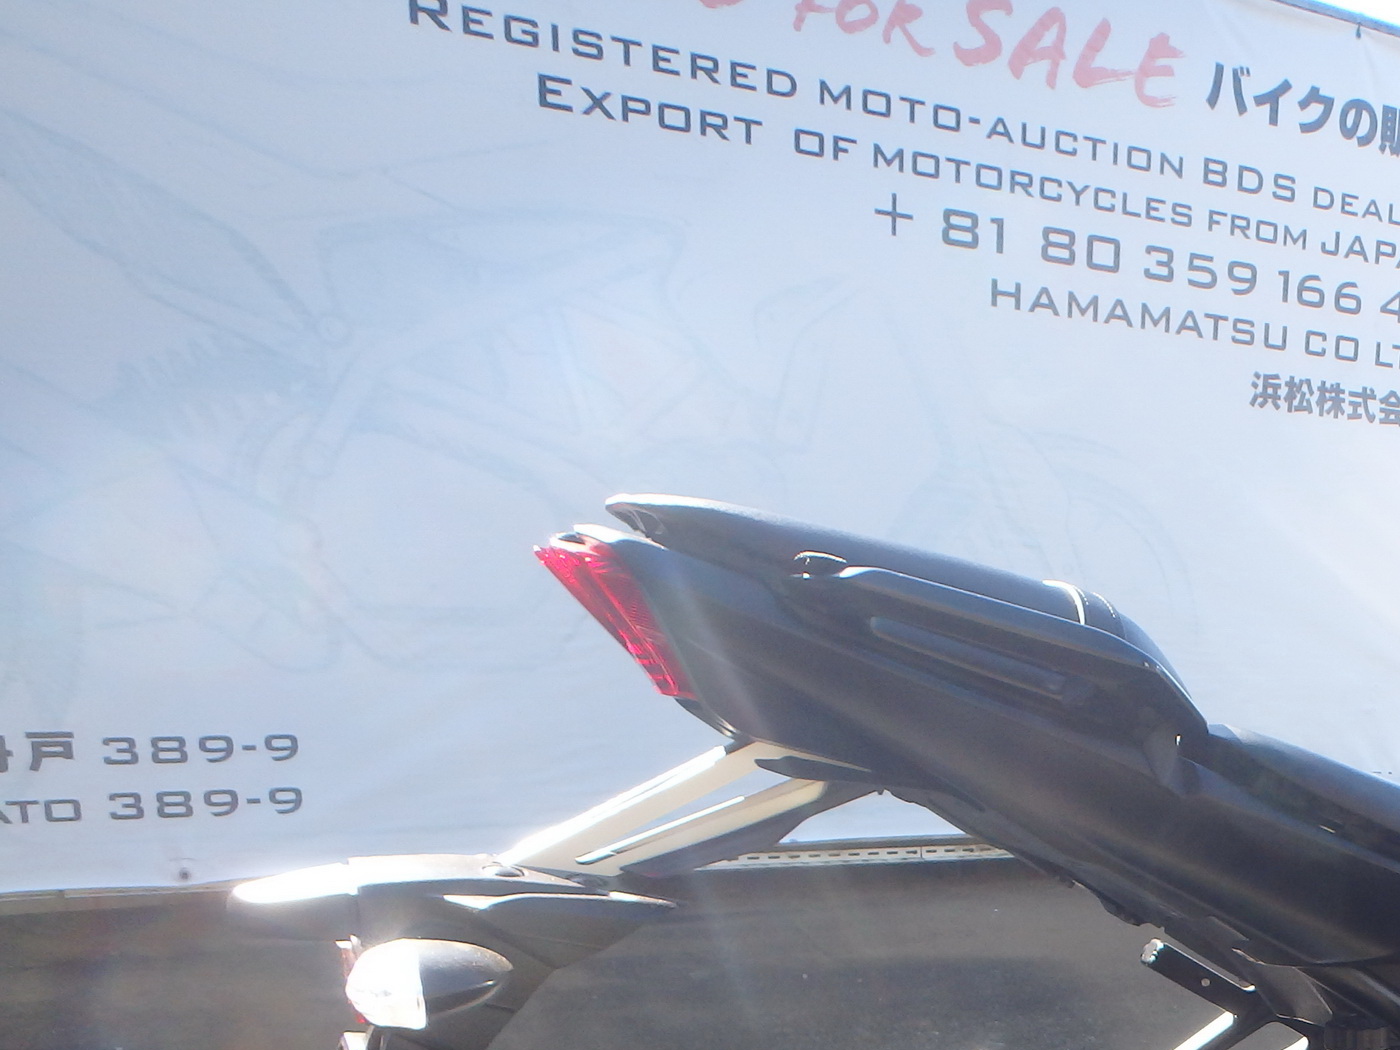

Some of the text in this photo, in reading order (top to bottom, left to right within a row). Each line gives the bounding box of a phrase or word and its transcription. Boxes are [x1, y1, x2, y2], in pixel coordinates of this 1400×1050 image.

[408, 0, 798, 99] REGISTERED
[818, 79, 1184, 180] MOTO-AUCTION
[1202, 157, 1297, 203] BDS
[953, 0, 1187, 109] SALE
[537, 73, 764, 146] EXPORT
[793, 128, 858, 162] OF
[873, 142, 1193, 228] MOTORCYCLES
[1207, 210, 1308, 251] FROM
[941, 208, 1005, 255] 81
[1040, 226, 1121, 274] 80
[1143, 245, 1258, 296] 359
[1277, 270, 1362, 316] 166
[990, 278, 1288, 352] HAMAMATSU
[1304, 329, 1360, 363] CO
[0, 731, 299, 774] 戸 389-9
[108, 787, 303, 821] 389-9
